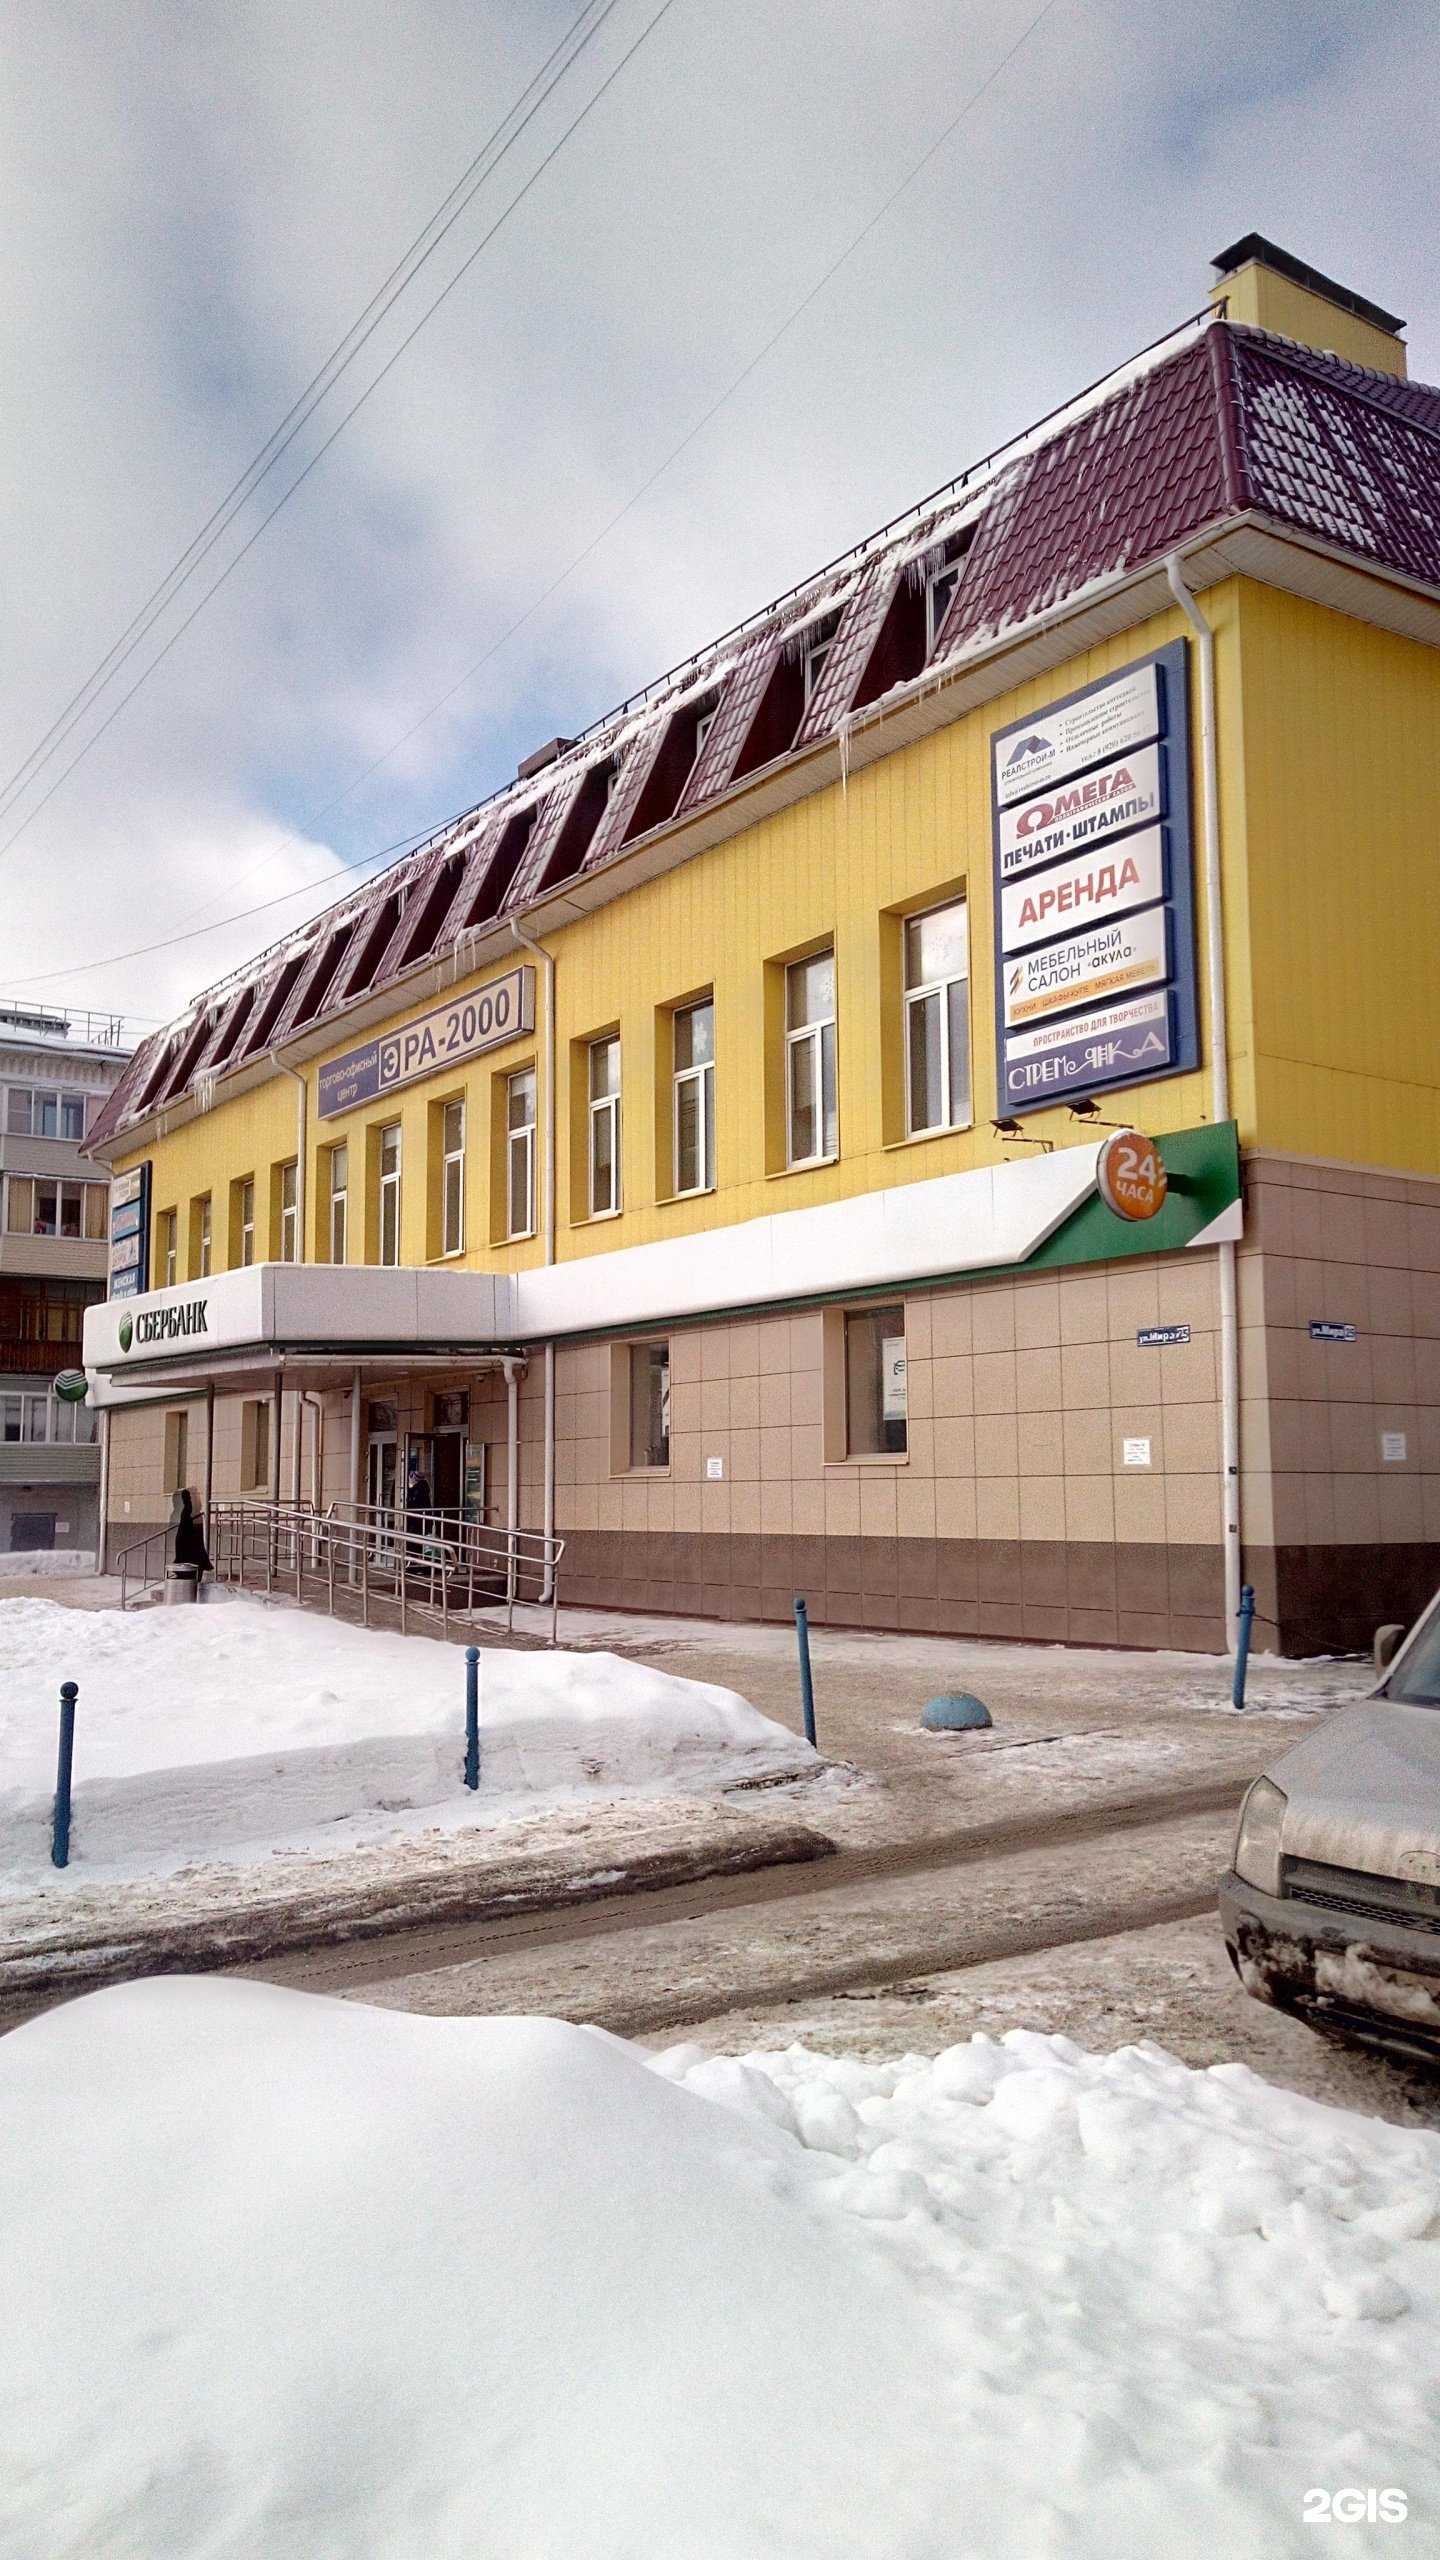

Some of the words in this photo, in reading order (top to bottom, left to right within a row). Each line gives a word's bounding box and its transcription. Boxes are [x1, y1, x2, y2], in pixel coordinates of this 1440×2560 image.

[1003, 829, 1064, 869] ПЕЧАТИ
[1072, 792, 1155, 841] ШТАМПЫ
[1018, 857, 1140, 928] АРЕНДА
[1028, 928, 1122, 976] МЕБЕЛЬНЫЙ
[1028, 963, 1081, 992] САЛОН
[1033, 1022, 1089, 1047] ПРОСТРАНСТВО
[1090, 1017, 1108, 1031] ДЛЯ
[1109, 1003, 1159, 1026] ТВОРЧЕСТВА
[337, 1082, 358, 1103] центр
[1118, 1146, 1156, 1186] 24
[1116, 1180, 1154, 1204] ЧАСА
[136, 1300, 209, 1344] СБЕРБАНК
